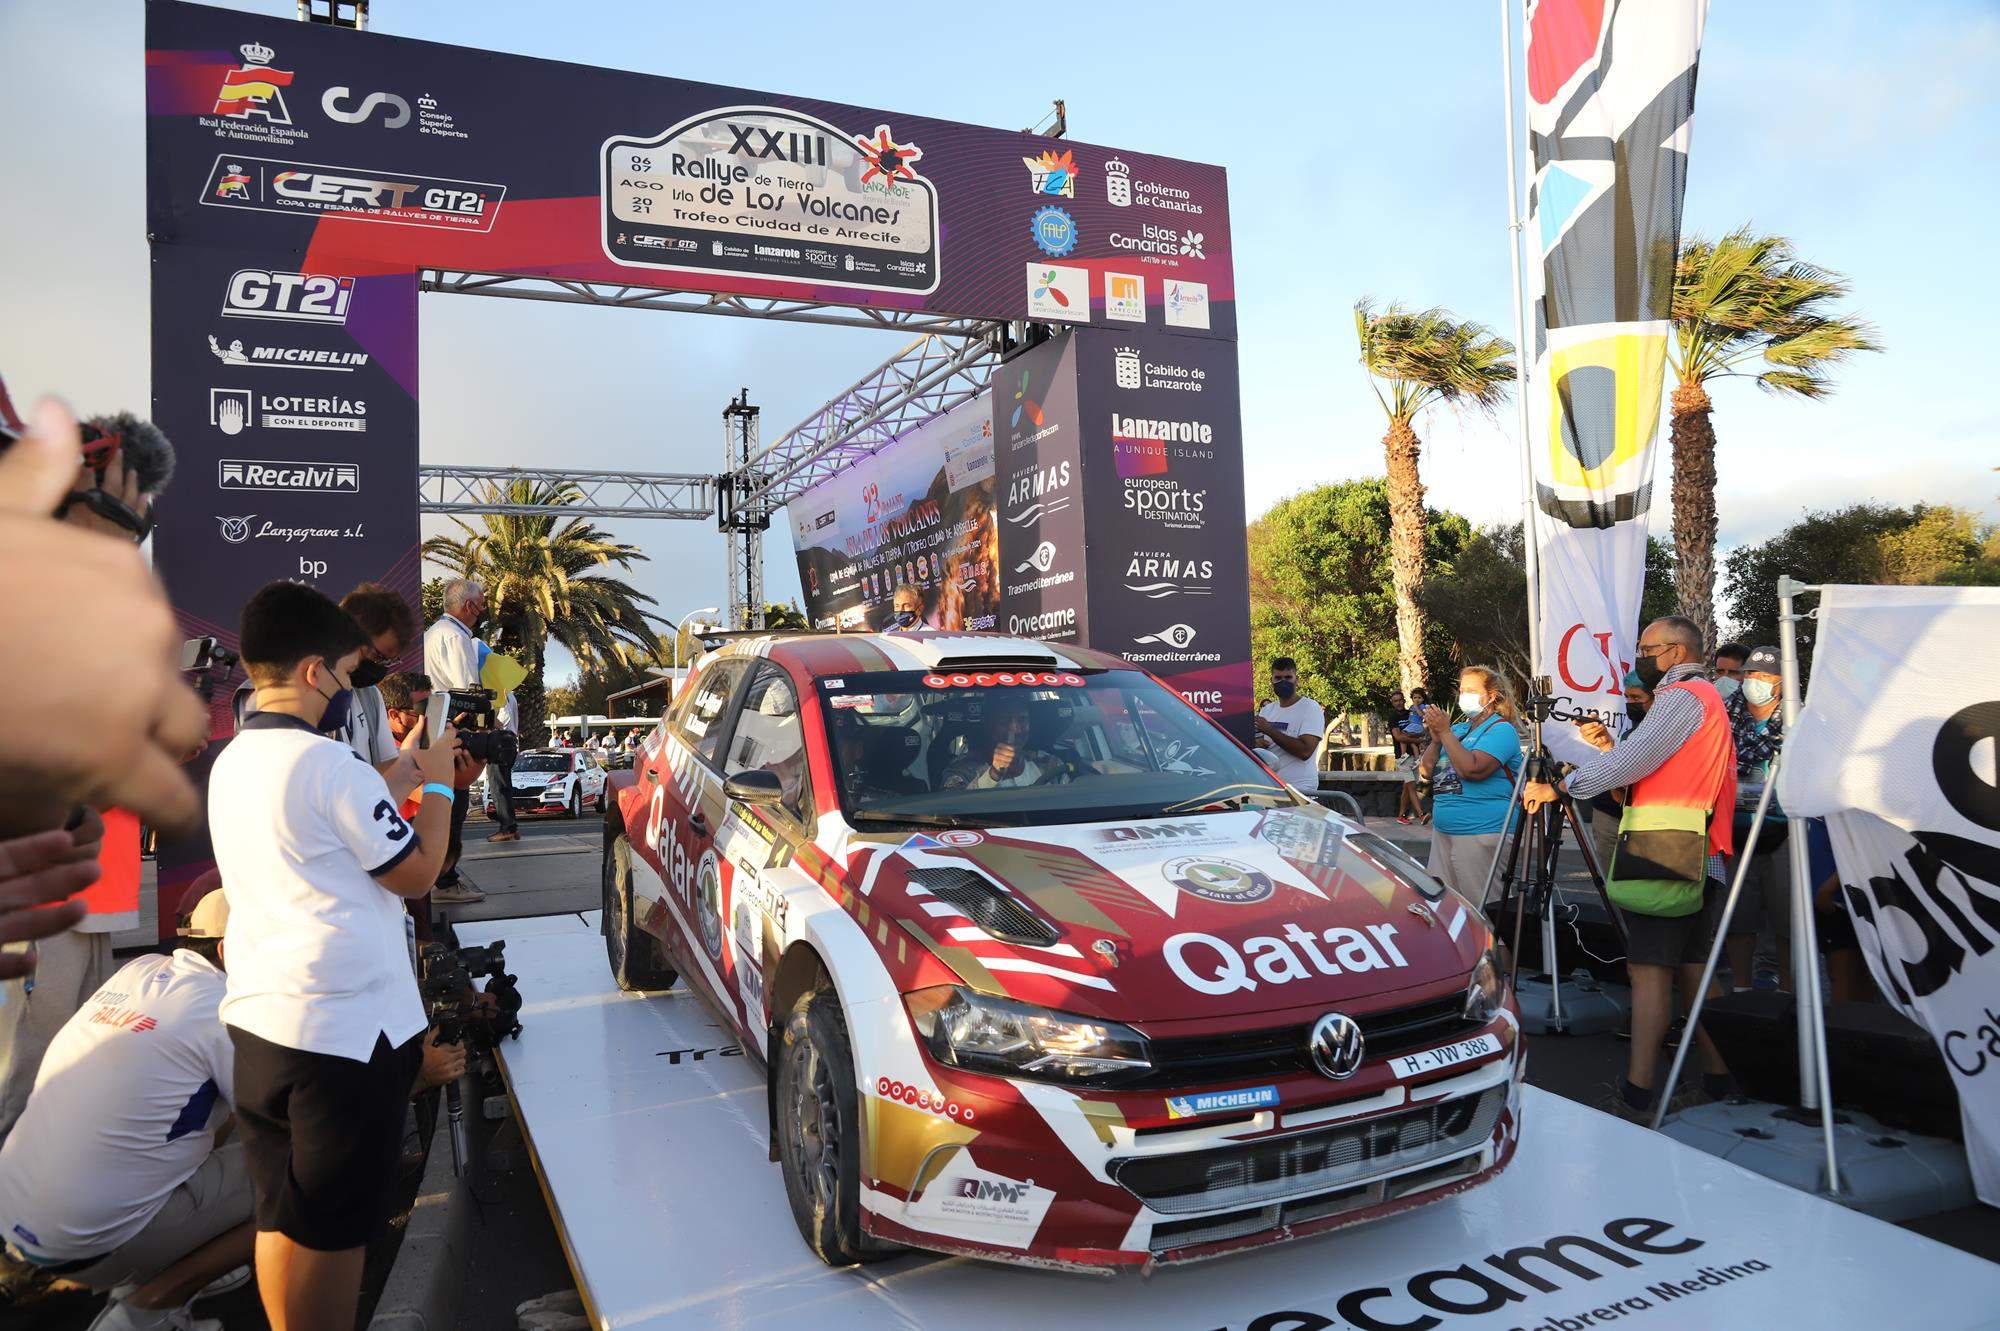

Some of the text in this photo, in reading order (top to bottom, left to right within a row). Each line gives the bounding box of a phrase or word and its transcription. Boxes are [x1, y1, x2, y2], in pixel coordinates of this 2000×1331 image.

[419, 110, 453, 121] Consejo
[419, 118, 454, 129] Superior
[199, 116, 309, 138] Real Federación Española
[214, 128, 294, 145] de Automovilismo
[419, 126, 469, 139] de Deportes
[727, 124, 826, 166] XXIII
[631, 155, 652, 165] 06
[631, 163, 652, 173] 07
[671, 153, 815, 192] Rallye de Tierra
[272, 171, 488, 212] CERT GT2i
[619, 179, 664, 191] AGO
[1134, 181, 1190, 199] Gobierno
[276, 199, 306, 207] COPA
[308, 201, 322, 209] DE
[324, 202, 366, 213] ESPAÑA
[367, 207, 381, 215] DE
[383, 209, 428, 219] RALLYES
[444, 216, 480, 225] TIERRA
[631, 196, 653, 206] 20
[631, 204, 651, 214] 21
[672, 187, 694, 203] Isla
[699, 182, 734, 207] de
[745, 187, 784, 211] Los
[797, 192, 901, 226] Volcanes
[1135, 194, 1203, 214] de Canarias
[672, 208, 901, 245] Trofeo Ciudad de Arrecife
[1142, 224, 1177, 242] Islas
[754, 244, 800, 259] Lanzarote
[1109, 233, 1179, 256] Canarias
[804, 253, 838, 264] sports
[228, 271, 352, 316] GT2i
[252, 346, 369, 366] MICHELIN
[1144, 362, 1206, 380] Cabildo de
[1145, 376, 1202, 392] Lanzarote
[261, 395, 367, 415] LOTERÍAS
[274, 418, 355, 429] CON EL DEPORTE
[1112, 413, 1213, 444] Lanzarote
[1113, 444, 1214, 460] A UNIQUE ISLAND
[245, 465, 335, 488] Recalvi
[1012, 463, 1039, 480] NAVIERA
[1007, 460, 1070, 507] ARMAS
[1124, 478, 1178, 491] european
[863, 482, 882, 524] 23
[1123, 488, 1204, 516] sports
[863, 527, 875, 548] DE
[875, 520, 891, 545] LOS
[890, 498, 941, 539] VOLCANES
[1144, 510, 1200, 522] DESTINATION
[255, 521, 364, 543] Lanzagrava s.l.
[299, 556, 328, 578] bp
[1125, 558, 1214, 580] ARMAS
[1007, 570, 1075, 597] Trasmediterránea
[1009, 607, 1076, 636] Orvecame
[1121, 651, 1222, 662] Trasmediterránea
[929, 672, 1081, 687] ooredoo
[373, 799, 411, 842] 3
[645, 784, 695, 910] Qatar
[1162, 923, 1409, 996] Qatar
[1403, 1055, 1421, 1073] H
[1429, 1046, 1460, 1065] VW
[1460, 1037, 1489, 1057] 388
[879, 1080, 975, 1120] ooredoo
[1197, 1089, 1272, 1110] MICHELIN
[953, 1177, 1030, 1204] QMMF
[1645, 1258, 1772, 1302] Medina
